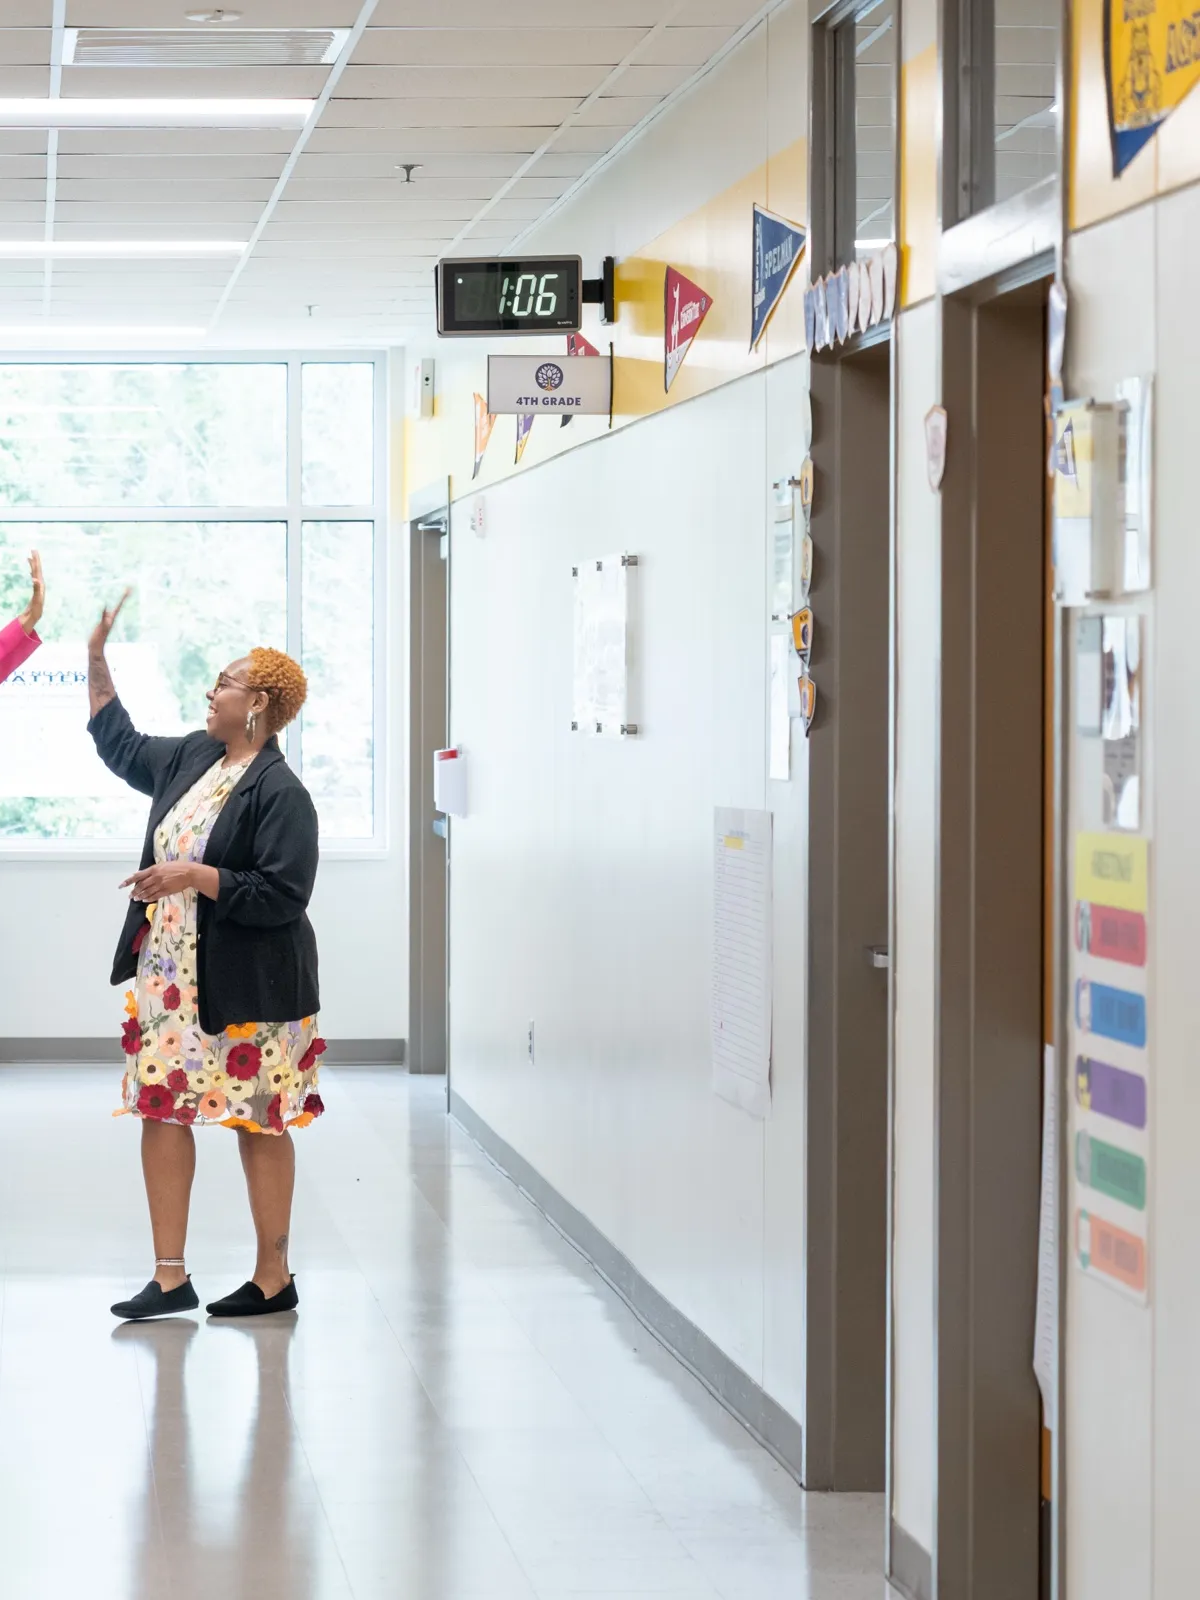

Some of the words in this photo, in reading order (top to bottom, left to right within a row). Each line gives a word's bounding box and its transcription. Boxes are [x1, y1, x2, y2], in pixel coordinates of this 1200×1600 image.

[764, 234, 793, 280] SPELMAN
[499, 274, 559, 316] 1:06
[516, 396, 538, 406] 4TH
[541, 396, 581, 406] GRADE
